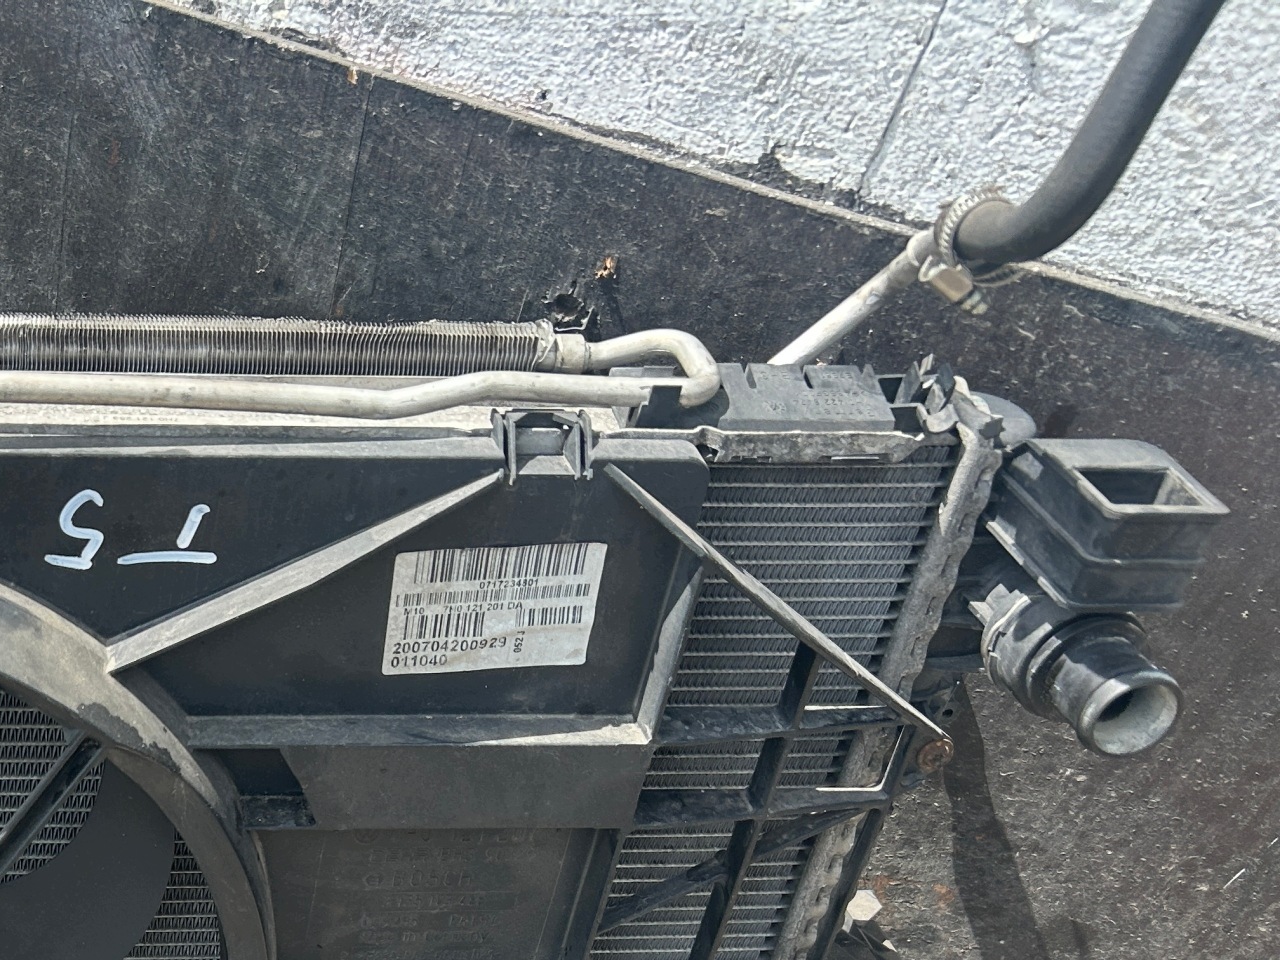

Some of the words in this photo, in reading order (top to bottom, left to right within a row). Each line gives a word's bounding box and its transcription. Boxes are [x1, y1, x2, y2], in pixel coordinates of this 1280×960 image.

[466, 603, 483, 612] 121
[487, 602, 504, 611] 201
[507, 601, 523, 610] DA
[392, 636, 507, 655] 200704200929
[390, 654, 448, 668] 011040
